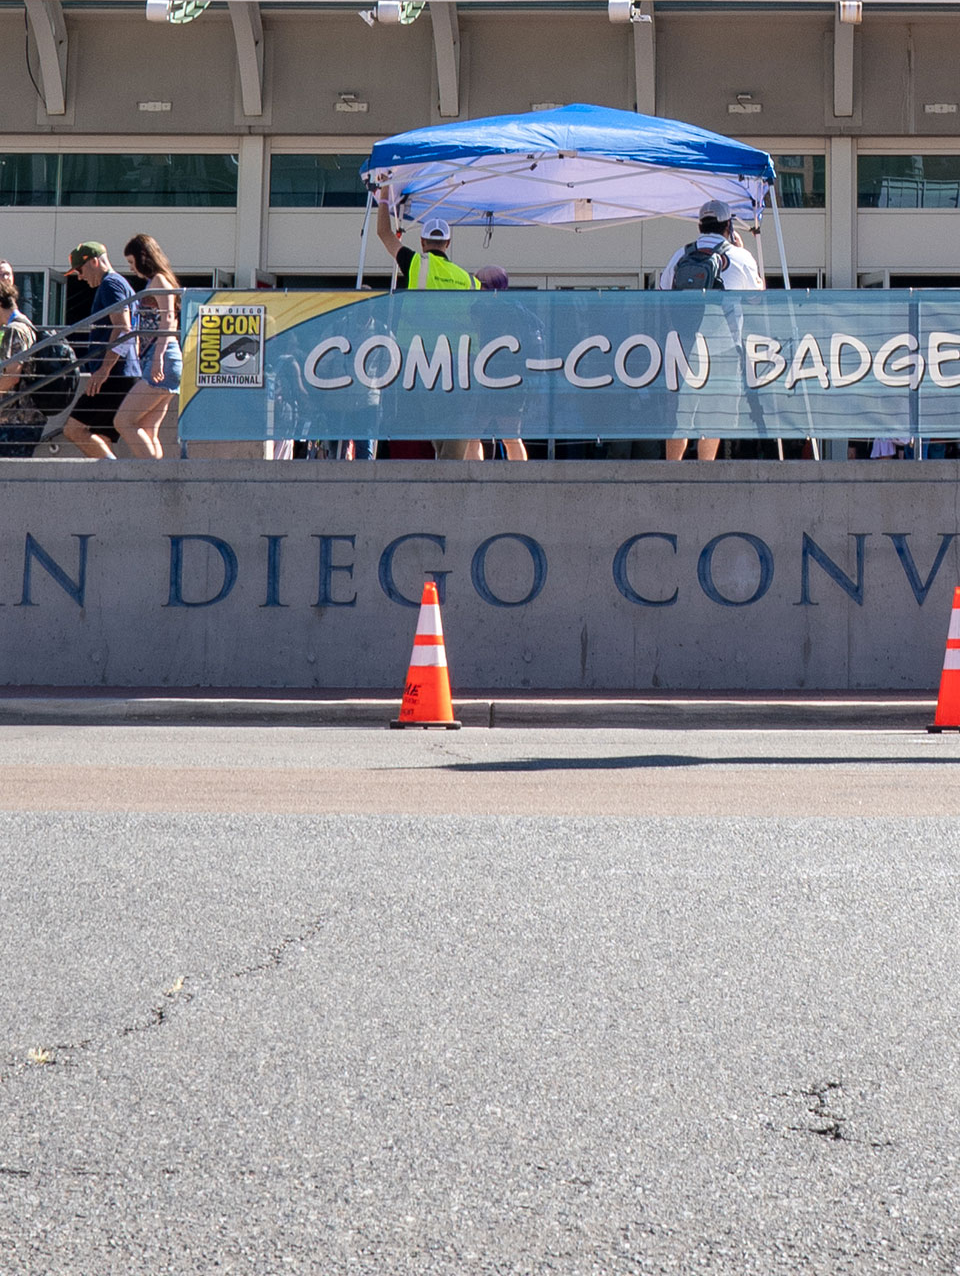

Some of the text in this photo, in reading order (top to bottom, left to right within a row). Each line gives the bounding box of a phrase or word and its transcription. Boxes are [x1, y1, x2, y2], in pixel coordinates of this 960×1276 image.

[200, 315, 221, 374] COMIC
[222, 315, 260, 335] CON
[198, 375, 260, 384] INTERNATIONAL
[303, 330, 711, 393] COMIC-CON
[0, 531, 96, 608] N
[160, 531, 548, 609] DIEGO
